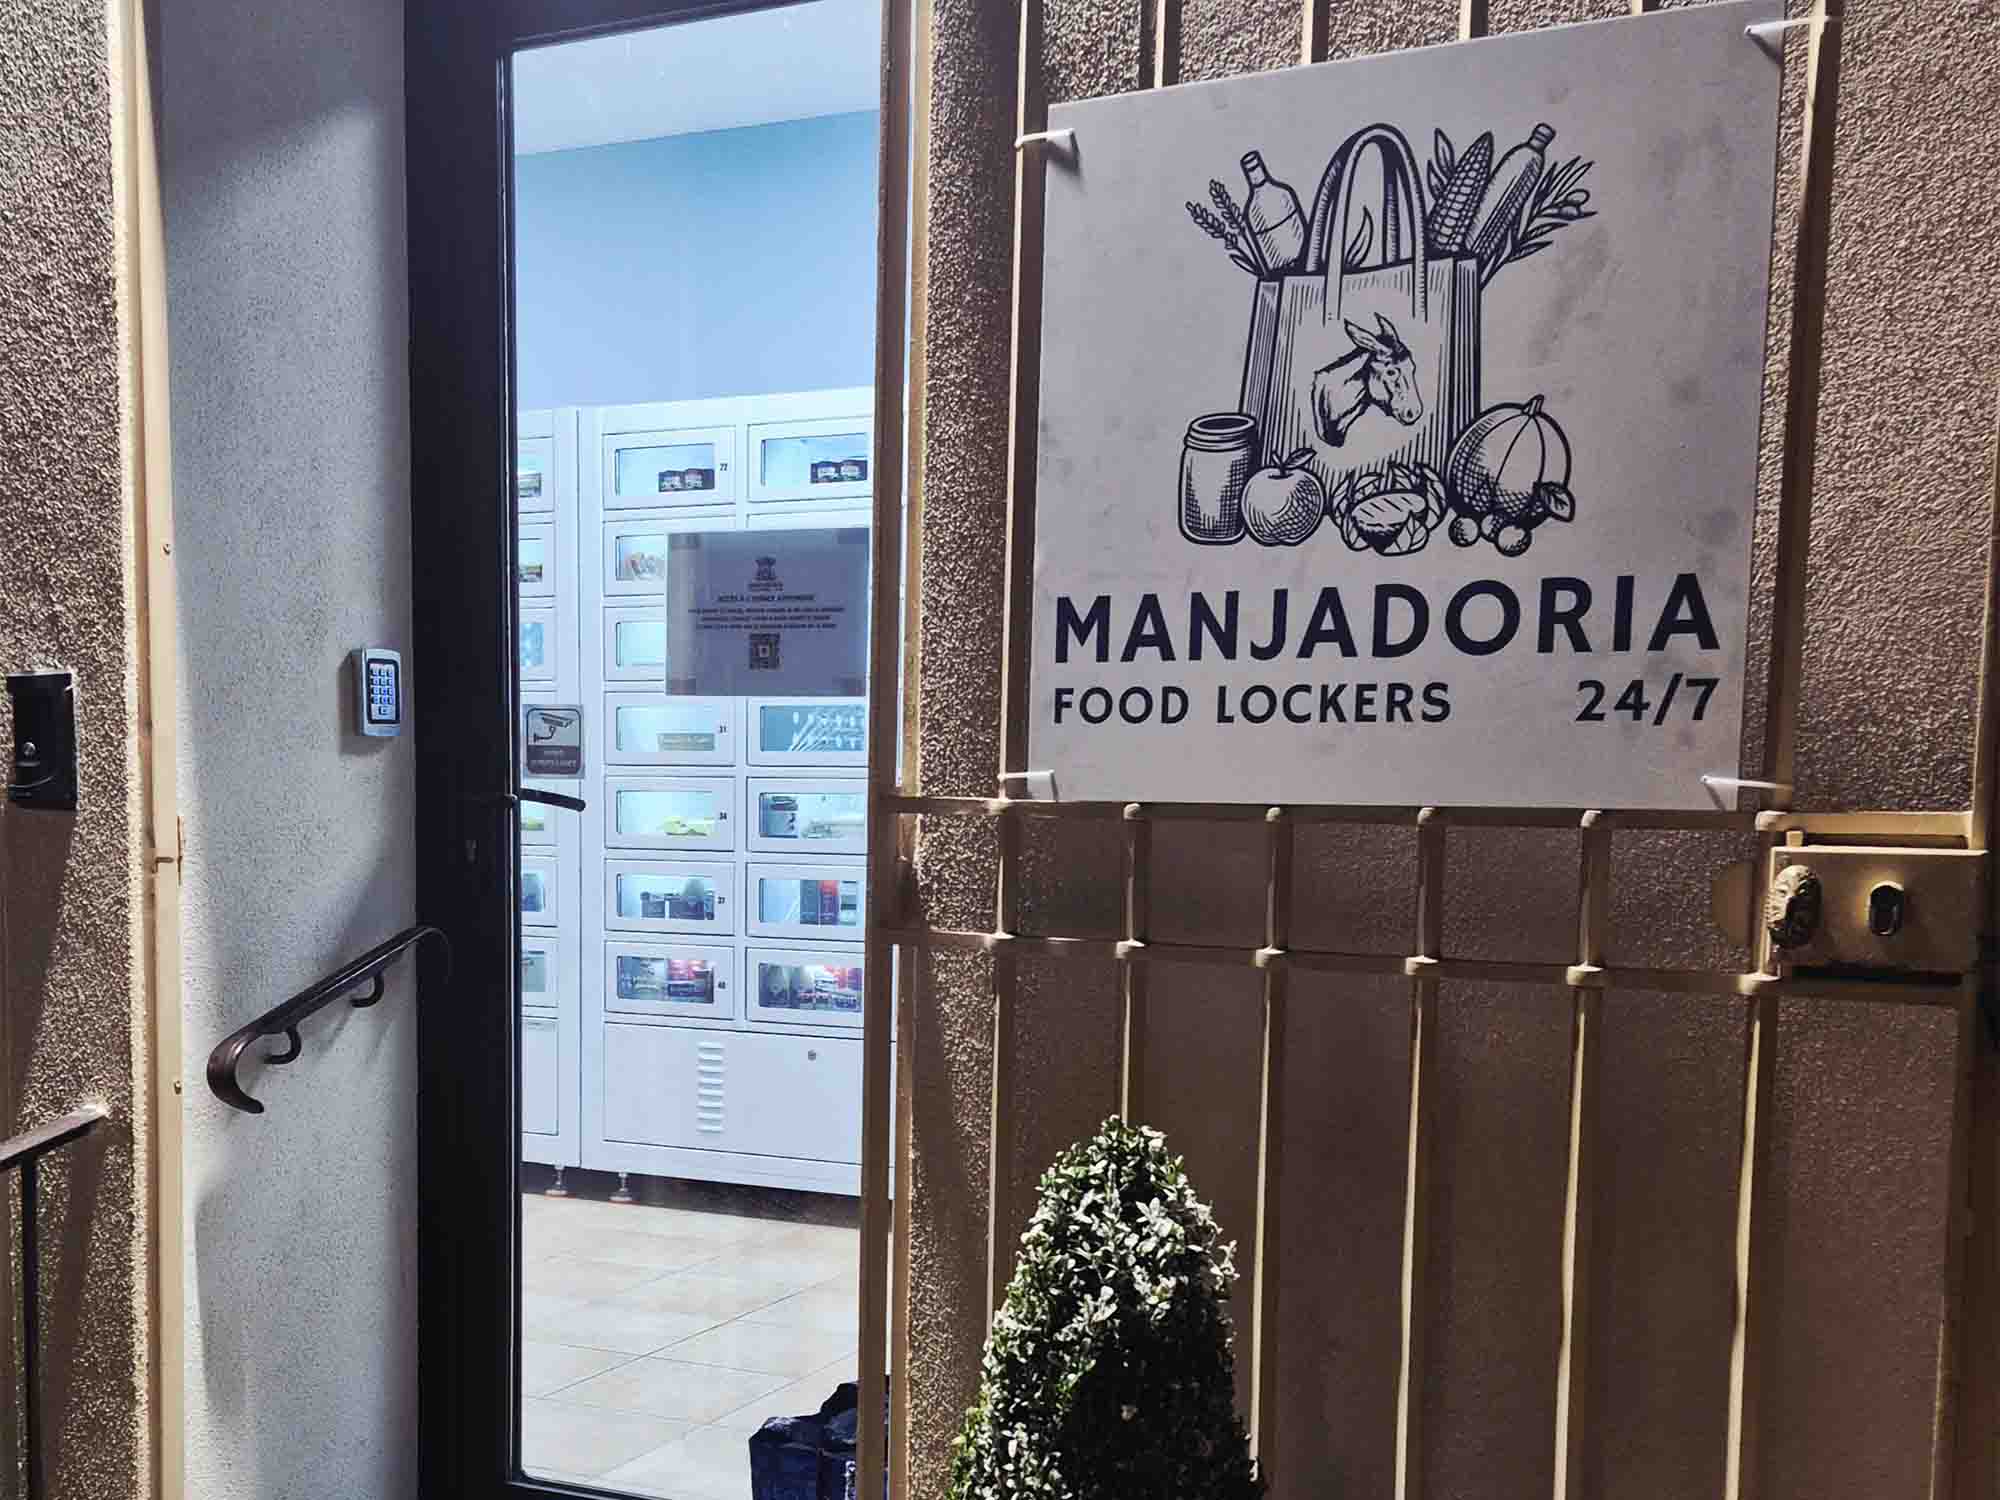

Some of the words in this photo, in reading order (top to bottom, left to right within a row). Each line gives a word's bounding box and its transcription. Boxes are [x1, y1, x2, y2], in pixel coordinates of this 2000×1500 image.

[1055, 572, 1721, 664] MANJADORIA
[1053, 686, 1189, 725] FOOD
[1216, 682, 1451, 724] LOCKERS
[1574, 672, 1721, 727] 24/7
